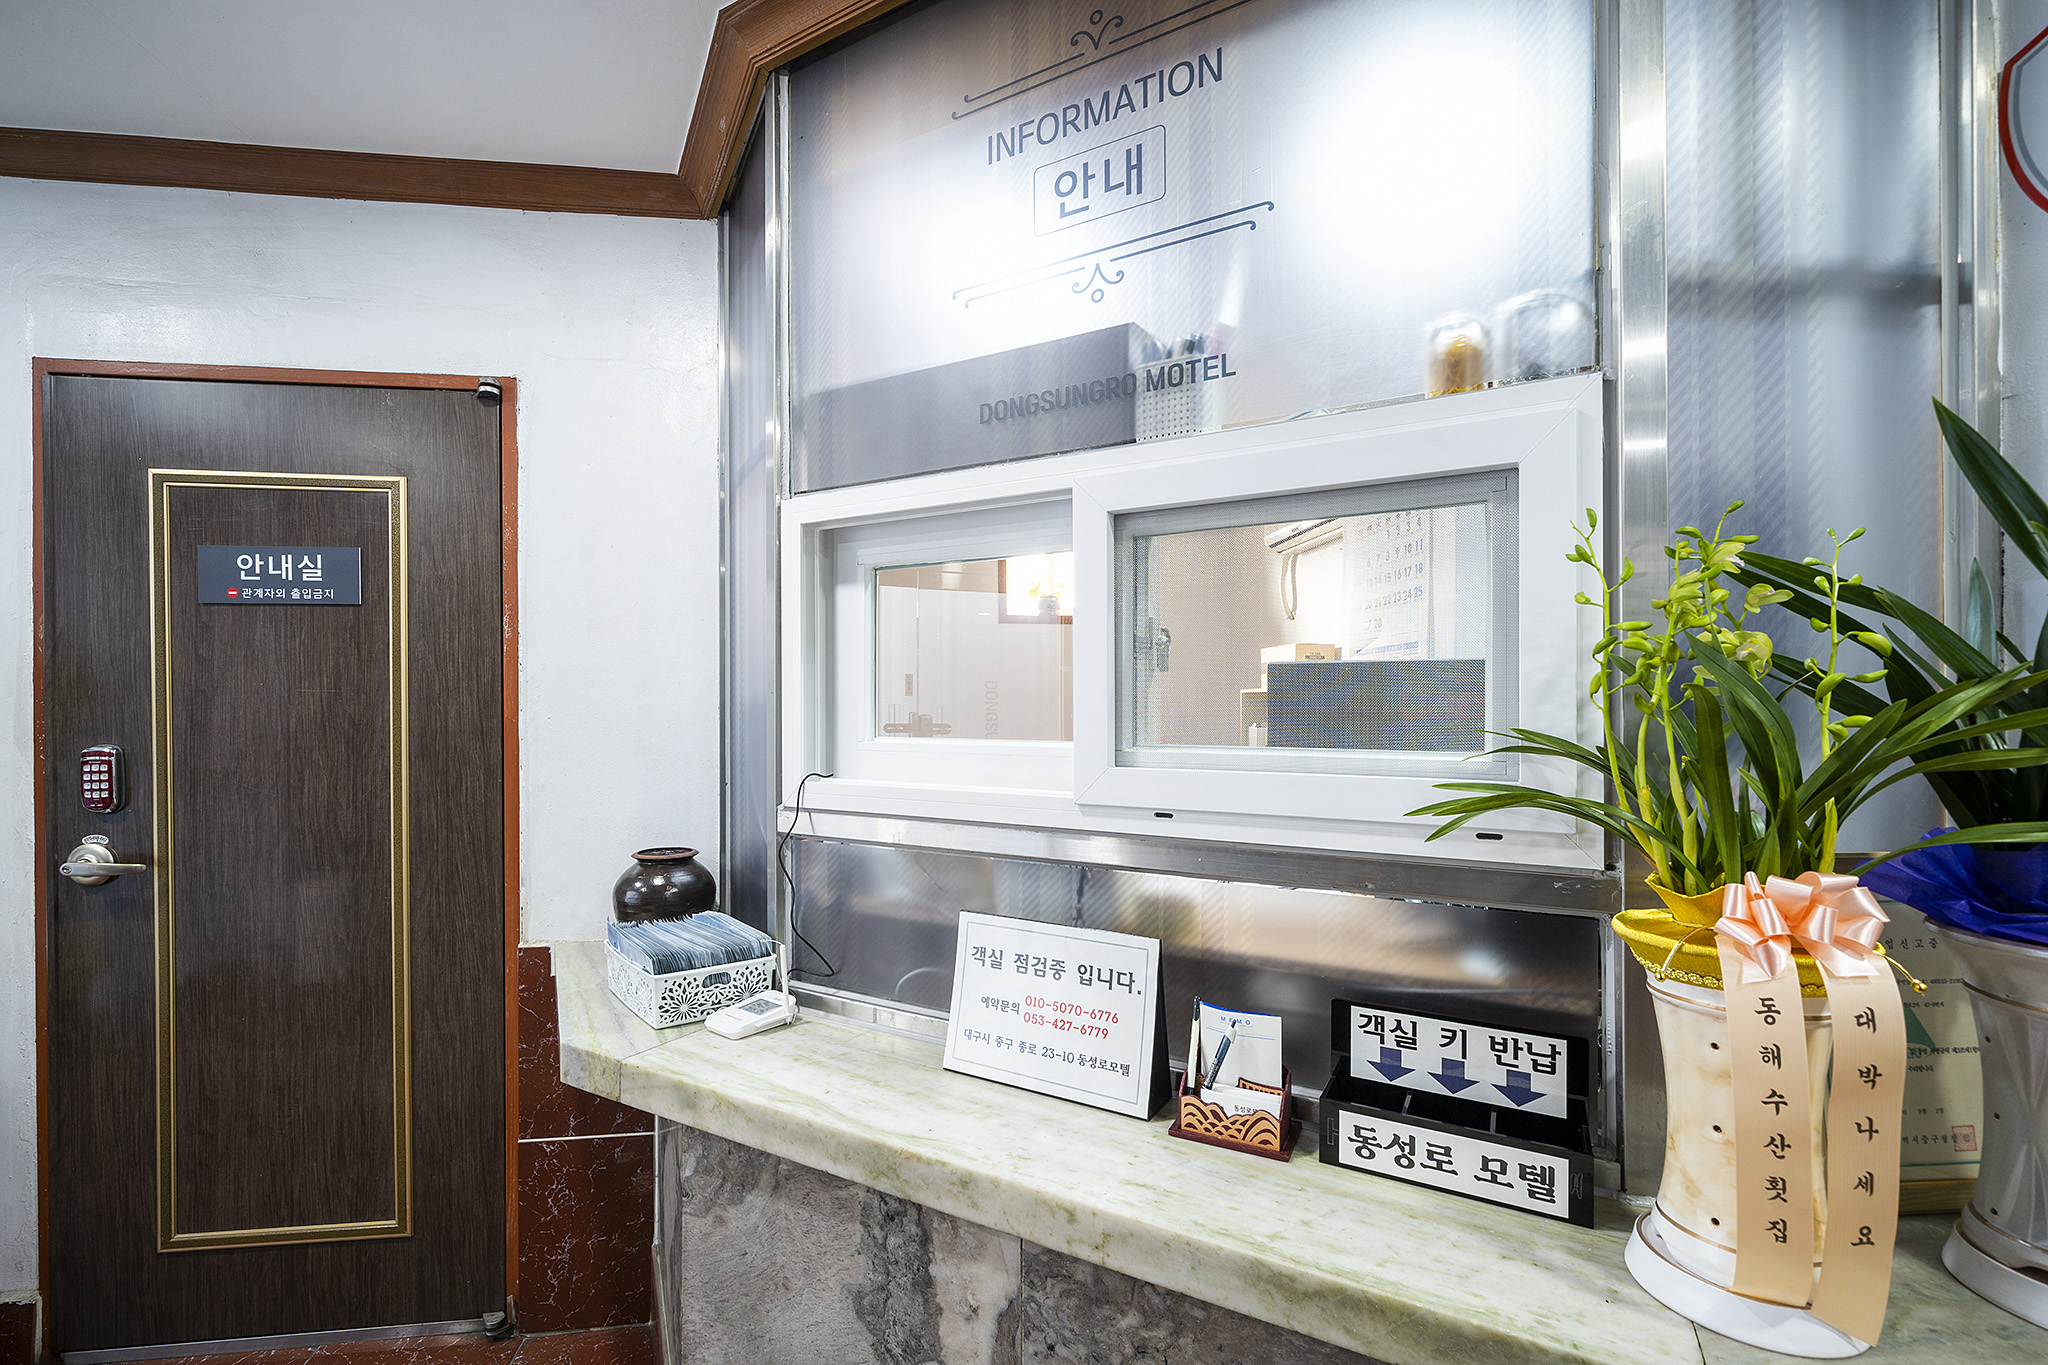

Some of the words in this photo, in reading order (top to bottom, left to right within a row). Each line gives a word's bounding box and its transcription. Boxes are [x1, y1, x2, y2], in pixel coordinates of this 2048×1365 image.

[987, 47, 1223, 164] INFORMATION
[1054, 143, 1143, 219] 안내
[979, 373, 1137, 425] DONGSUNGRO
[1145, 353, 1237, 393] MOTEL
[236, 553, 323, 582] 안내실
[241, 587, 286, 599] 관계자외
[290, 587, 335, 600] 출입금지
[971, 946, 1004, 970] 객실
[1013, 953, 1067, 981] 점검중
[1077, 963, 1143, 996] 입니다.
[980, 995, 1020, 1016] 예약문의
[1023, 1011, 1110, 1040] 053-427-6779
[1024, 995, 1120, 1025] 010-5070-6776
[963, 1028, 991, 1046] 대구시
[995, 1035, 1014, 1051] 중구
[1018, 1040, 1037, 1056] 종로
[1042, 1046, 1075, 1065] 23-10
[1076, 1054, 1131, 1078] 동성로모텔
[1357, 1012, 1418, 1052] 객실
[1438, 1027, 1468, 1060] 키
[1489, 1034, 1562, 1076] 반납
[1753, 996, 1793, 1245] 동해수산횟집
[1849, 1005, 1883, 1248] 대박나세요
[1346, 1123, 1460, 1177] 동성로
[1474, 1154, 1557, 1205] 모텔
